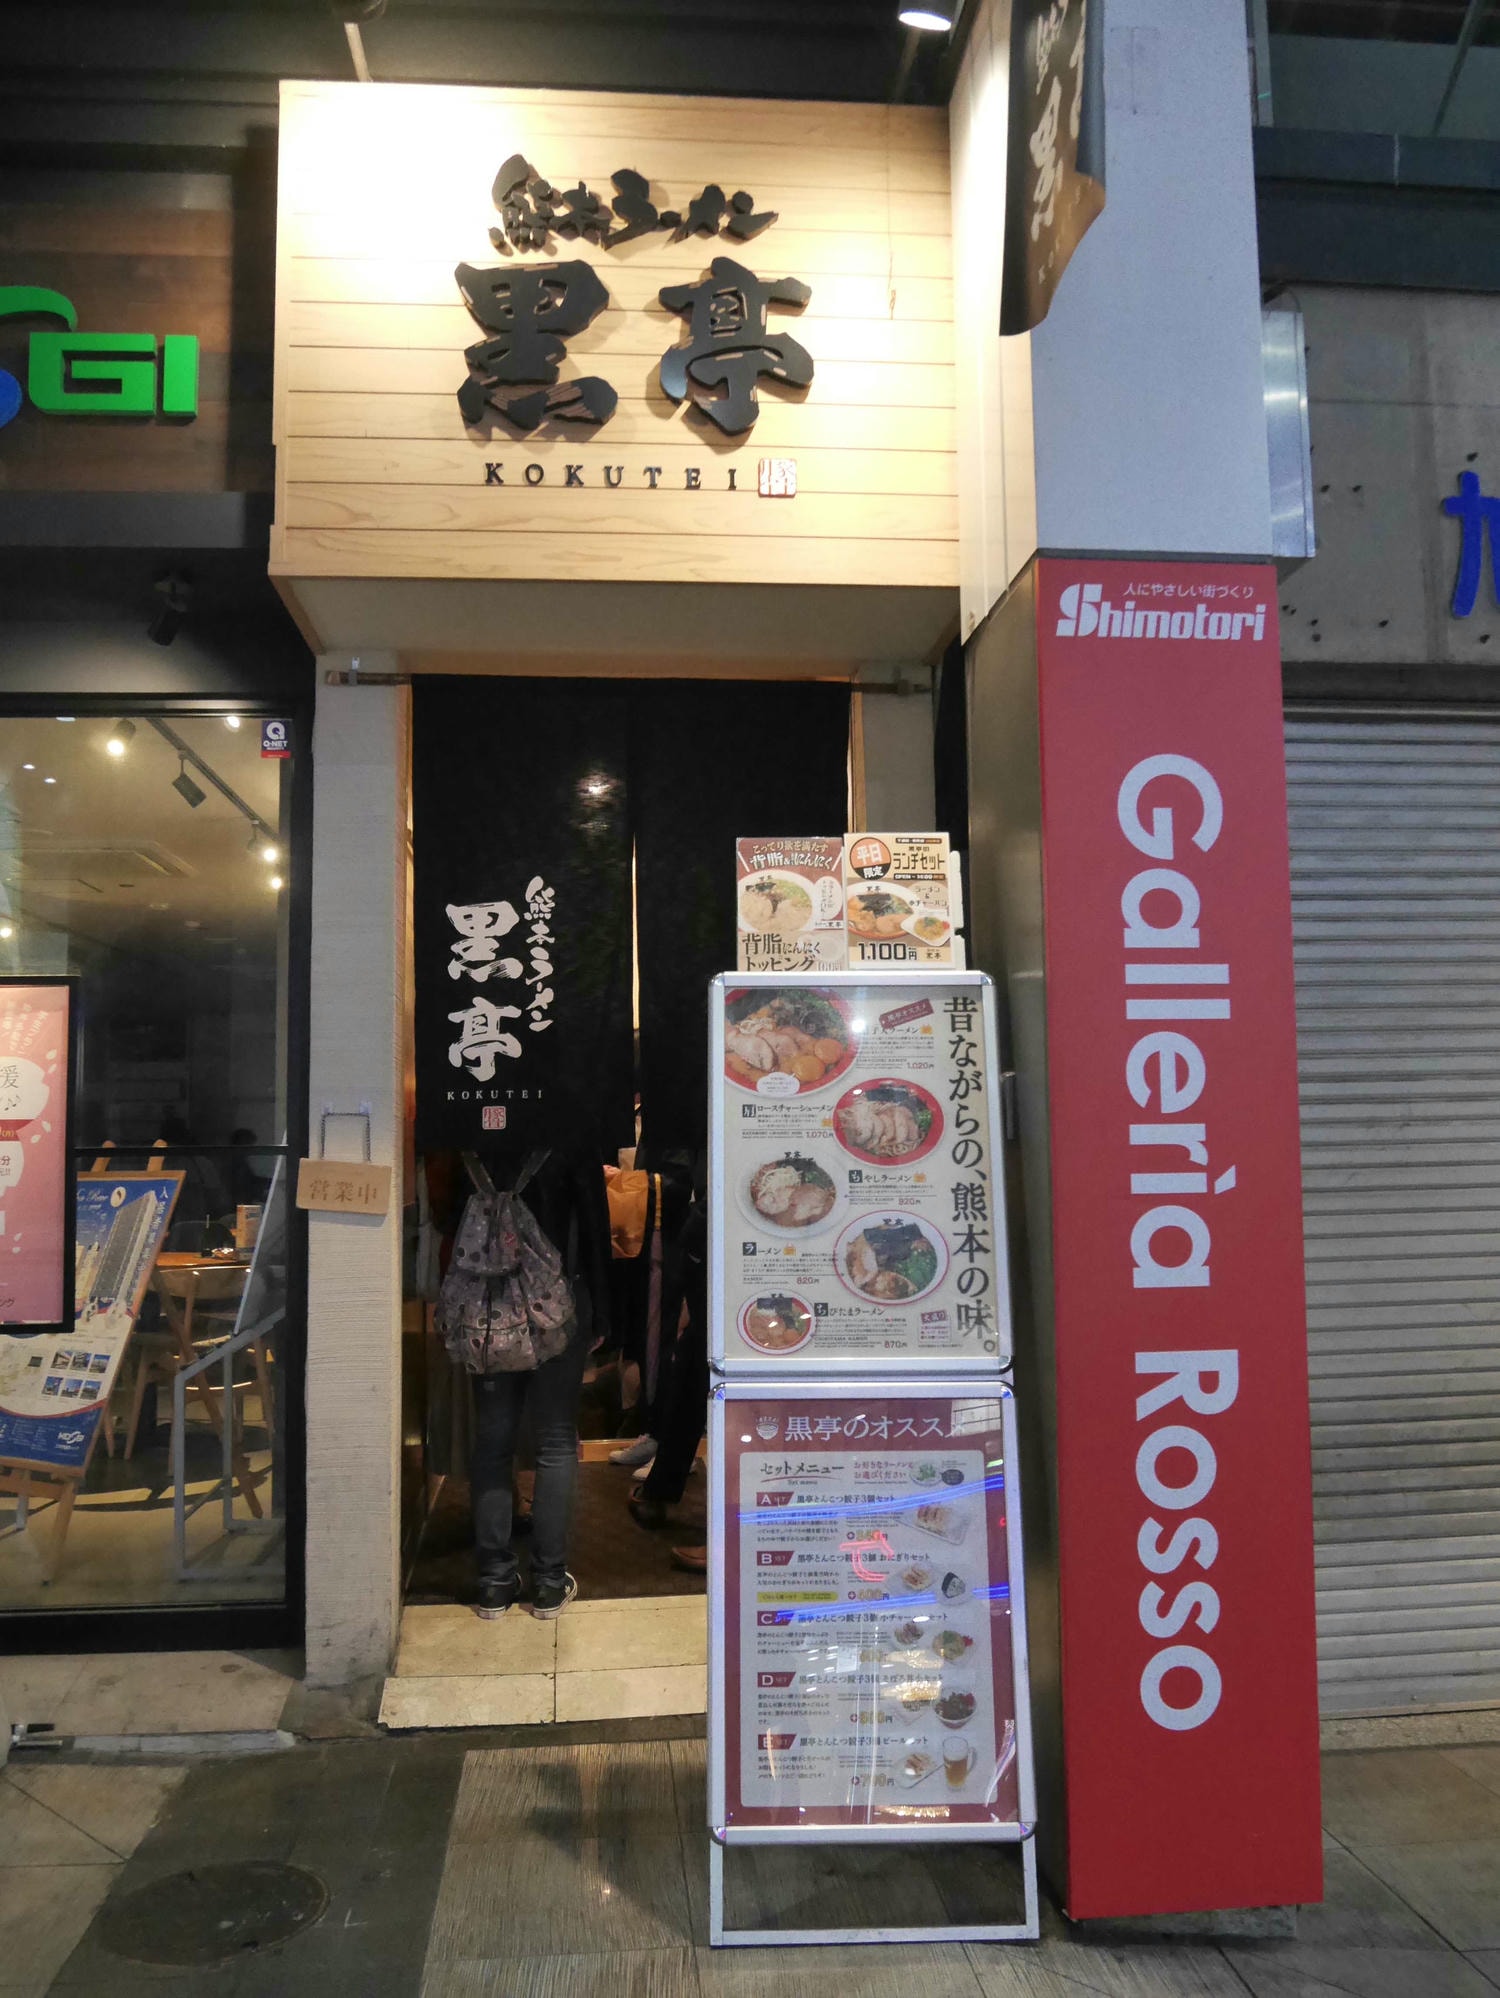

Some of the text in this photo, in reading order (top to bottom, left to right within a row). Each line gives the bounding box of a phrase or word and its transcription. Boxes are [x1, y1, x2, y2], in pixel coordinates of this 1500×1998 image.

[455, 257, 814, 434] 黒亭
[485, 462, 737, 490] KOKUTEI
[1123, 583, 1254, 598] 人にやさしい街づくり
[1056, 583, 1266, 641] Shimotori
[856, 842, 882, 865] 平日
[893, 853, 945, 870] ランチセット
[746, 955, 816, 971] トッピング
[445, 900, 523, 1082] 黒亭
[447, 1090, 543, 1101] KOKUTEI
[943, 996, 996, 1352] 昔ながらの、熊本の味。
[310, 1178, 377, 1204] 営業中
[761, 1494, 771, 1503] A
[1134, 1349, 1239, 1731] Rosso
[761, 1554, 772, 1563] B
[761, 1614, 772, 1624] C
[762, 1675, 773, 1685] D
